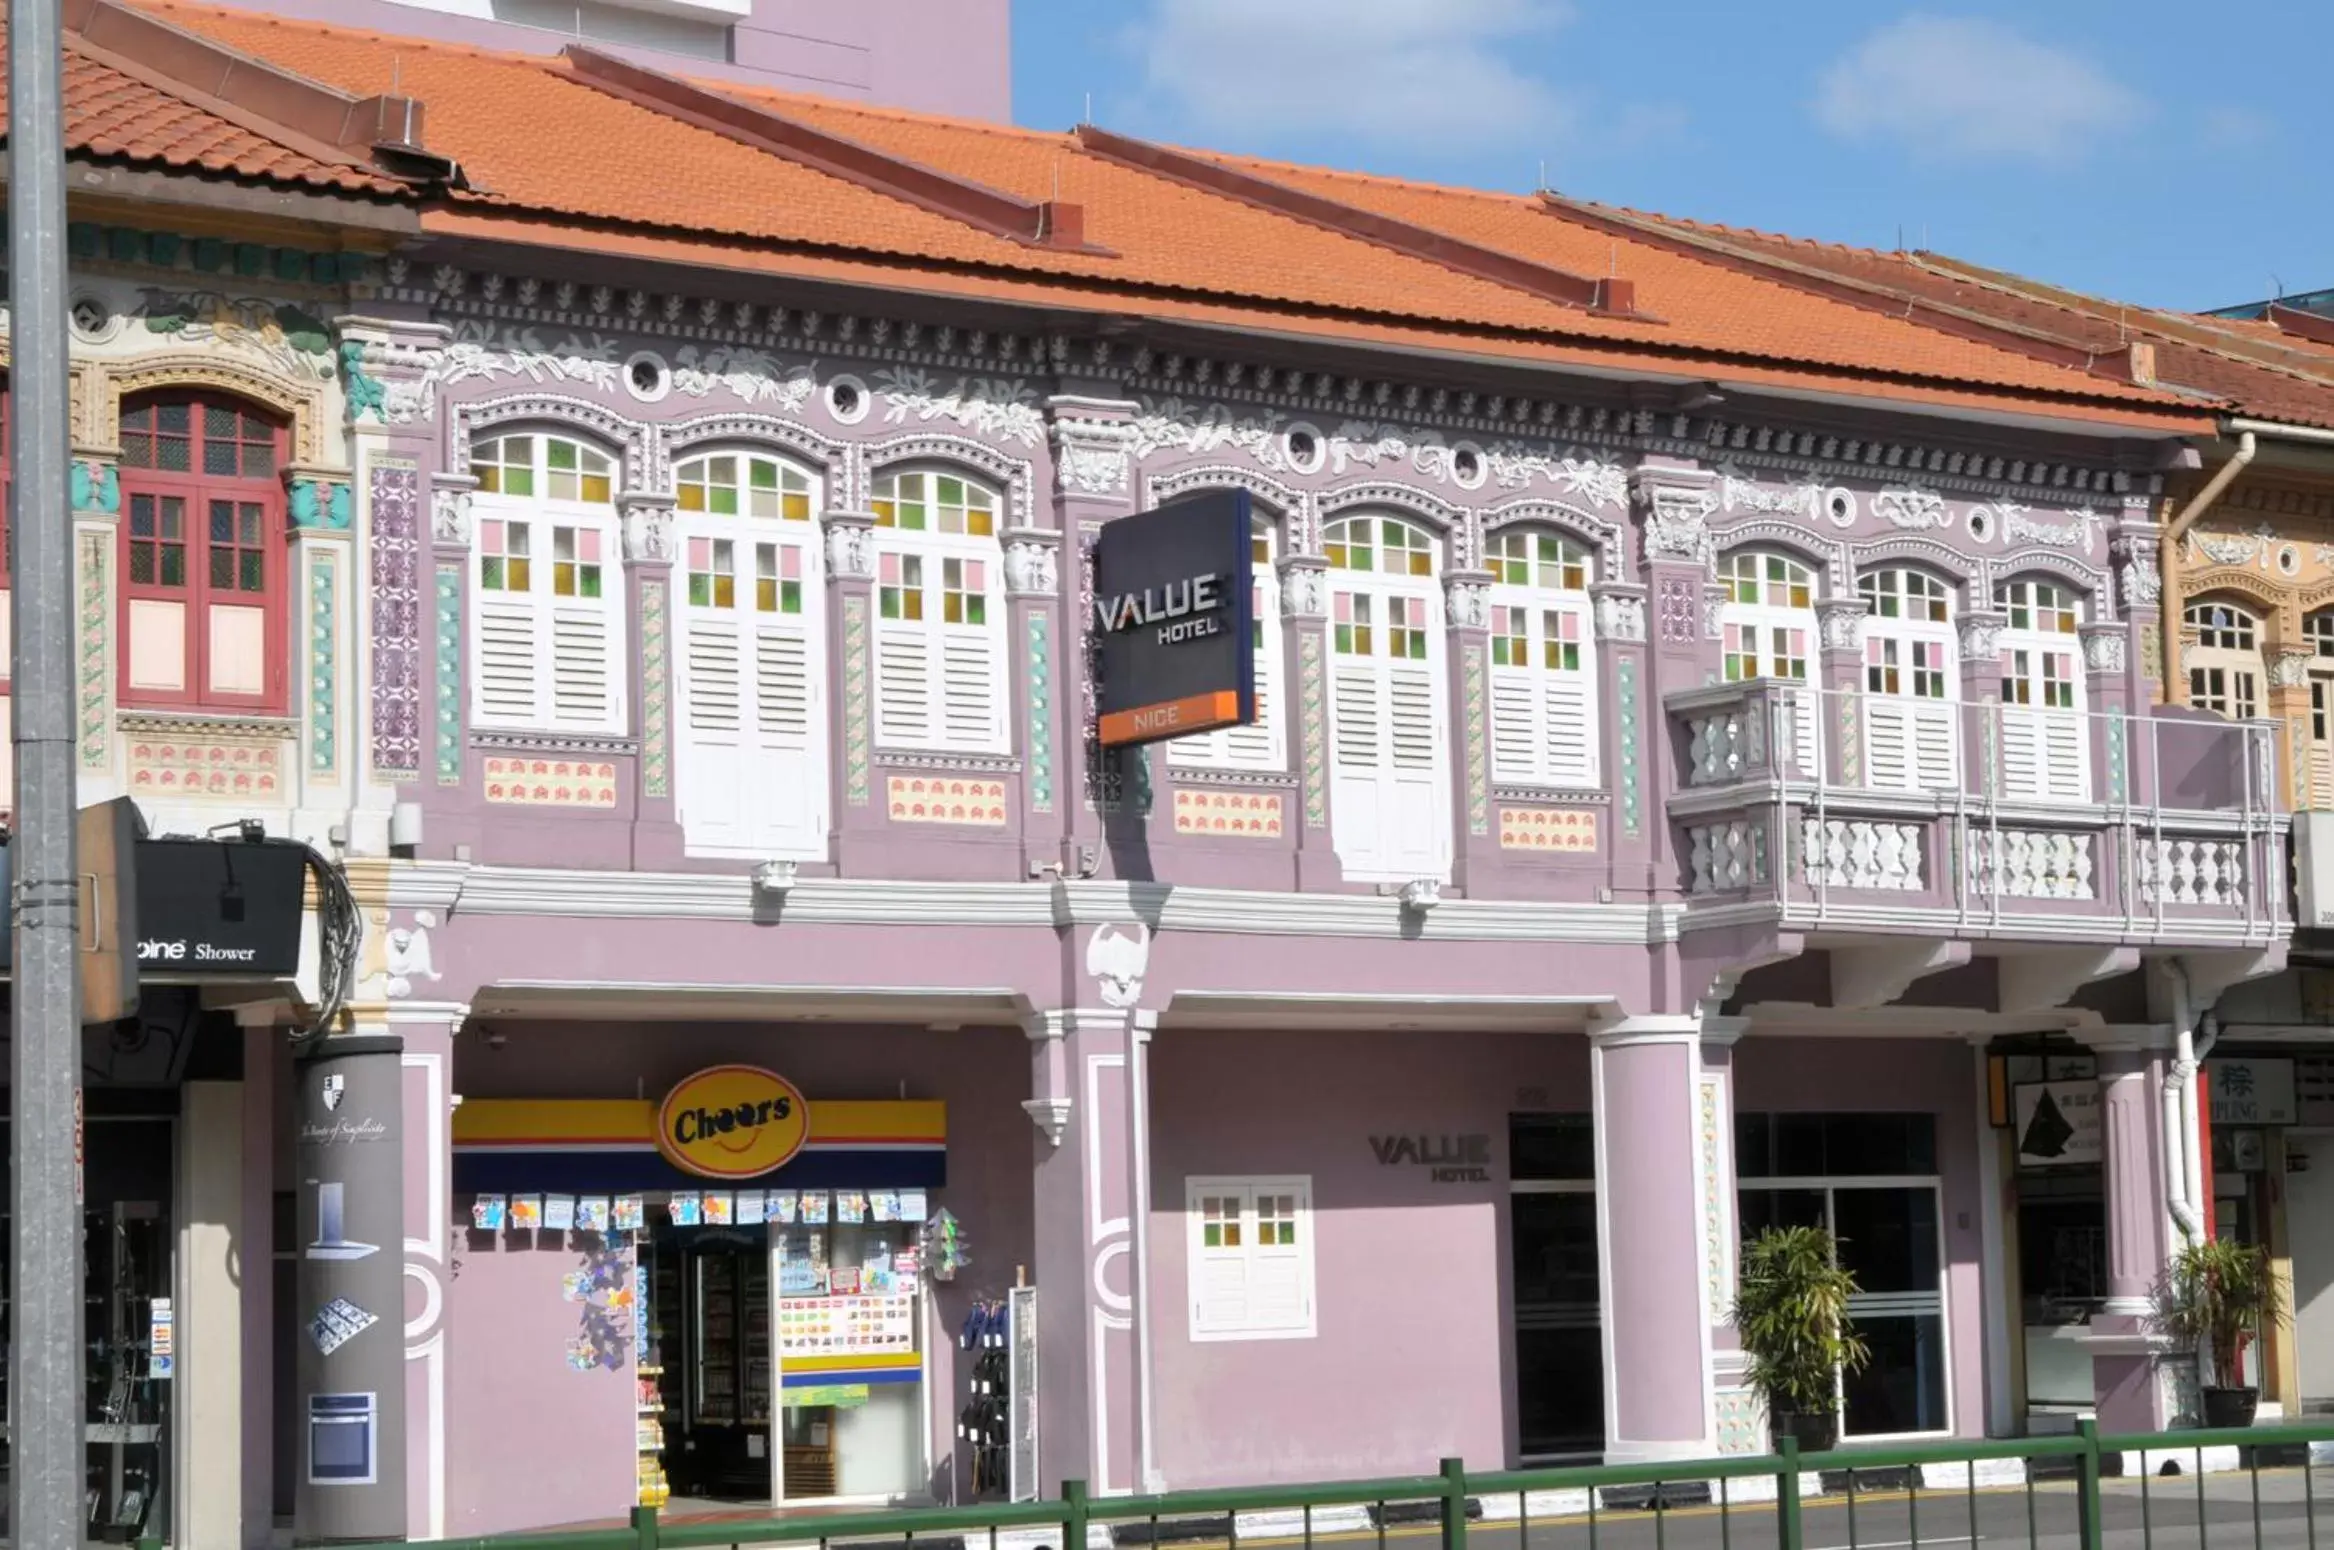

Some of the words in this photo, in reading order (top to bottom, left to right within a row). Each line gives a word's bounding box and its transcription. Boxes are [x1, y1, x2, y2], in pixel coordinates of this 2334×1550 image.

[1096, 572, 1217, 632] VALUE
[1158, 617, 1218, 645] HOTEL
[1134, 705, 1179, 733] NICE
[194, 942, 256, 961] Shower
[1367, 1134, 1492, 1166] VALUE
[1431, 1167, 1492, 1183] HOTEL
